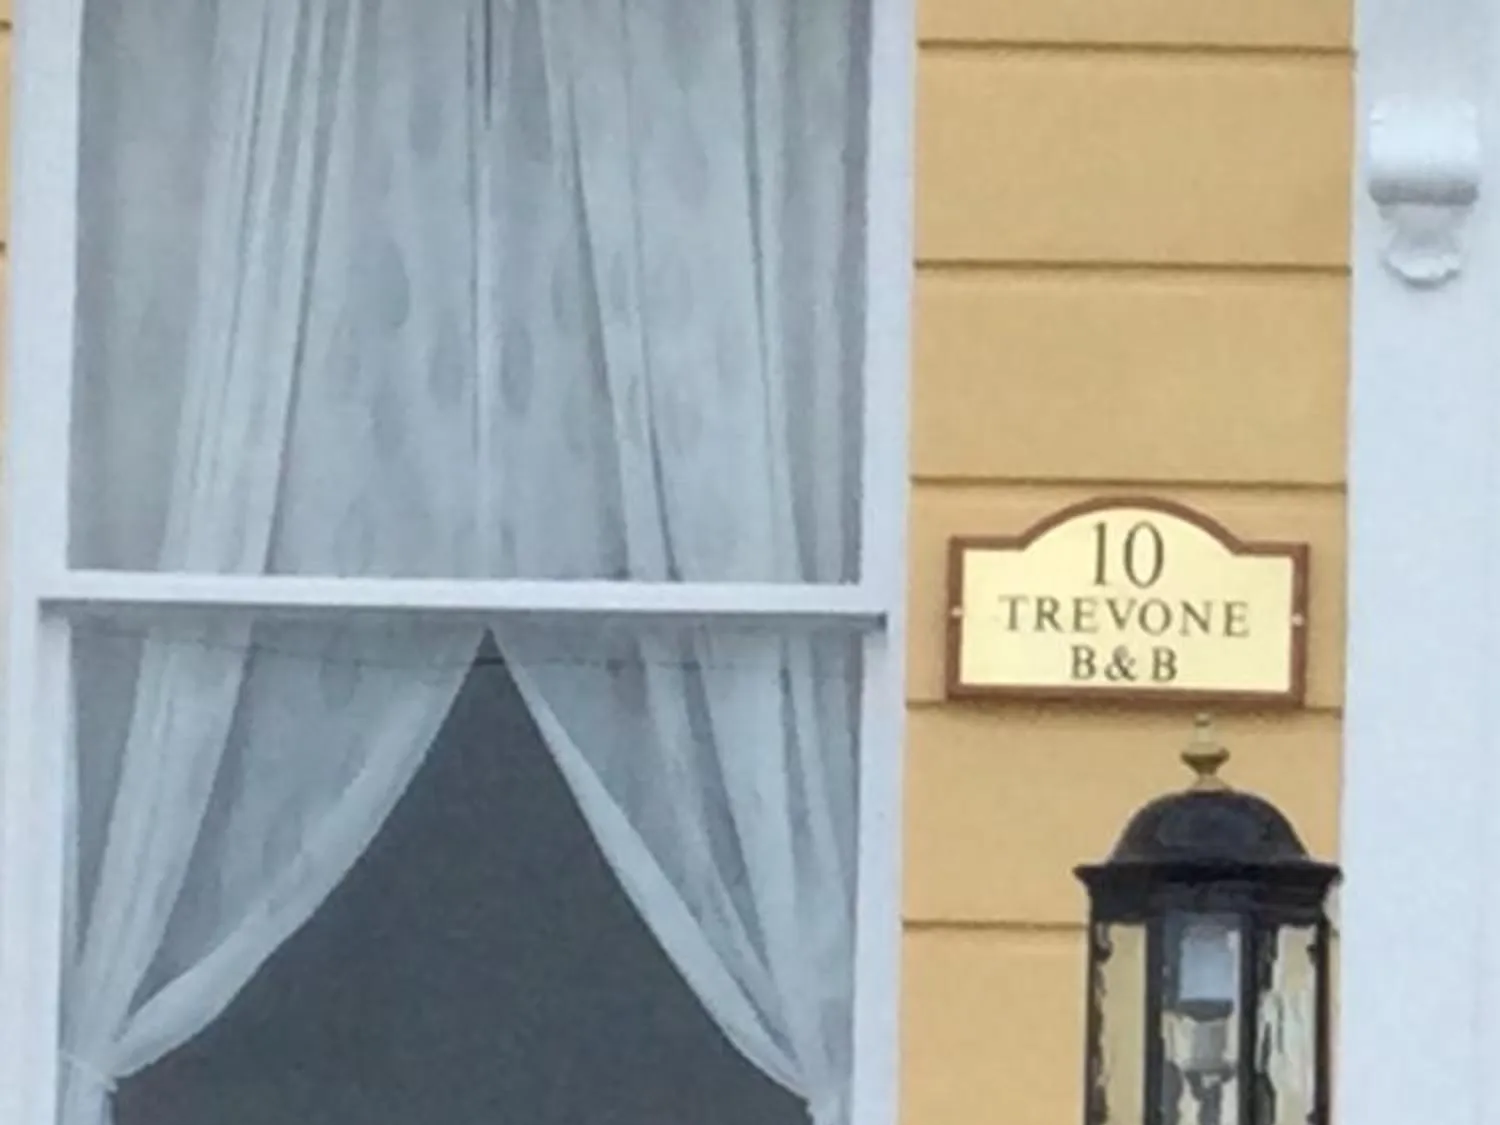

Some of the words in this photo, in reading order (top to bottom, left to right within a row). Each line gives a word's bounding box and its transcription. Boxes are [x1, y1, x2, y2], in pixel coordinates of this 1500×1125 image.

[1093, 520, 1165, 589] 10
[997, 594, 1251, 638] TREVONE
[1070, 644, 1179, 683] B&B
